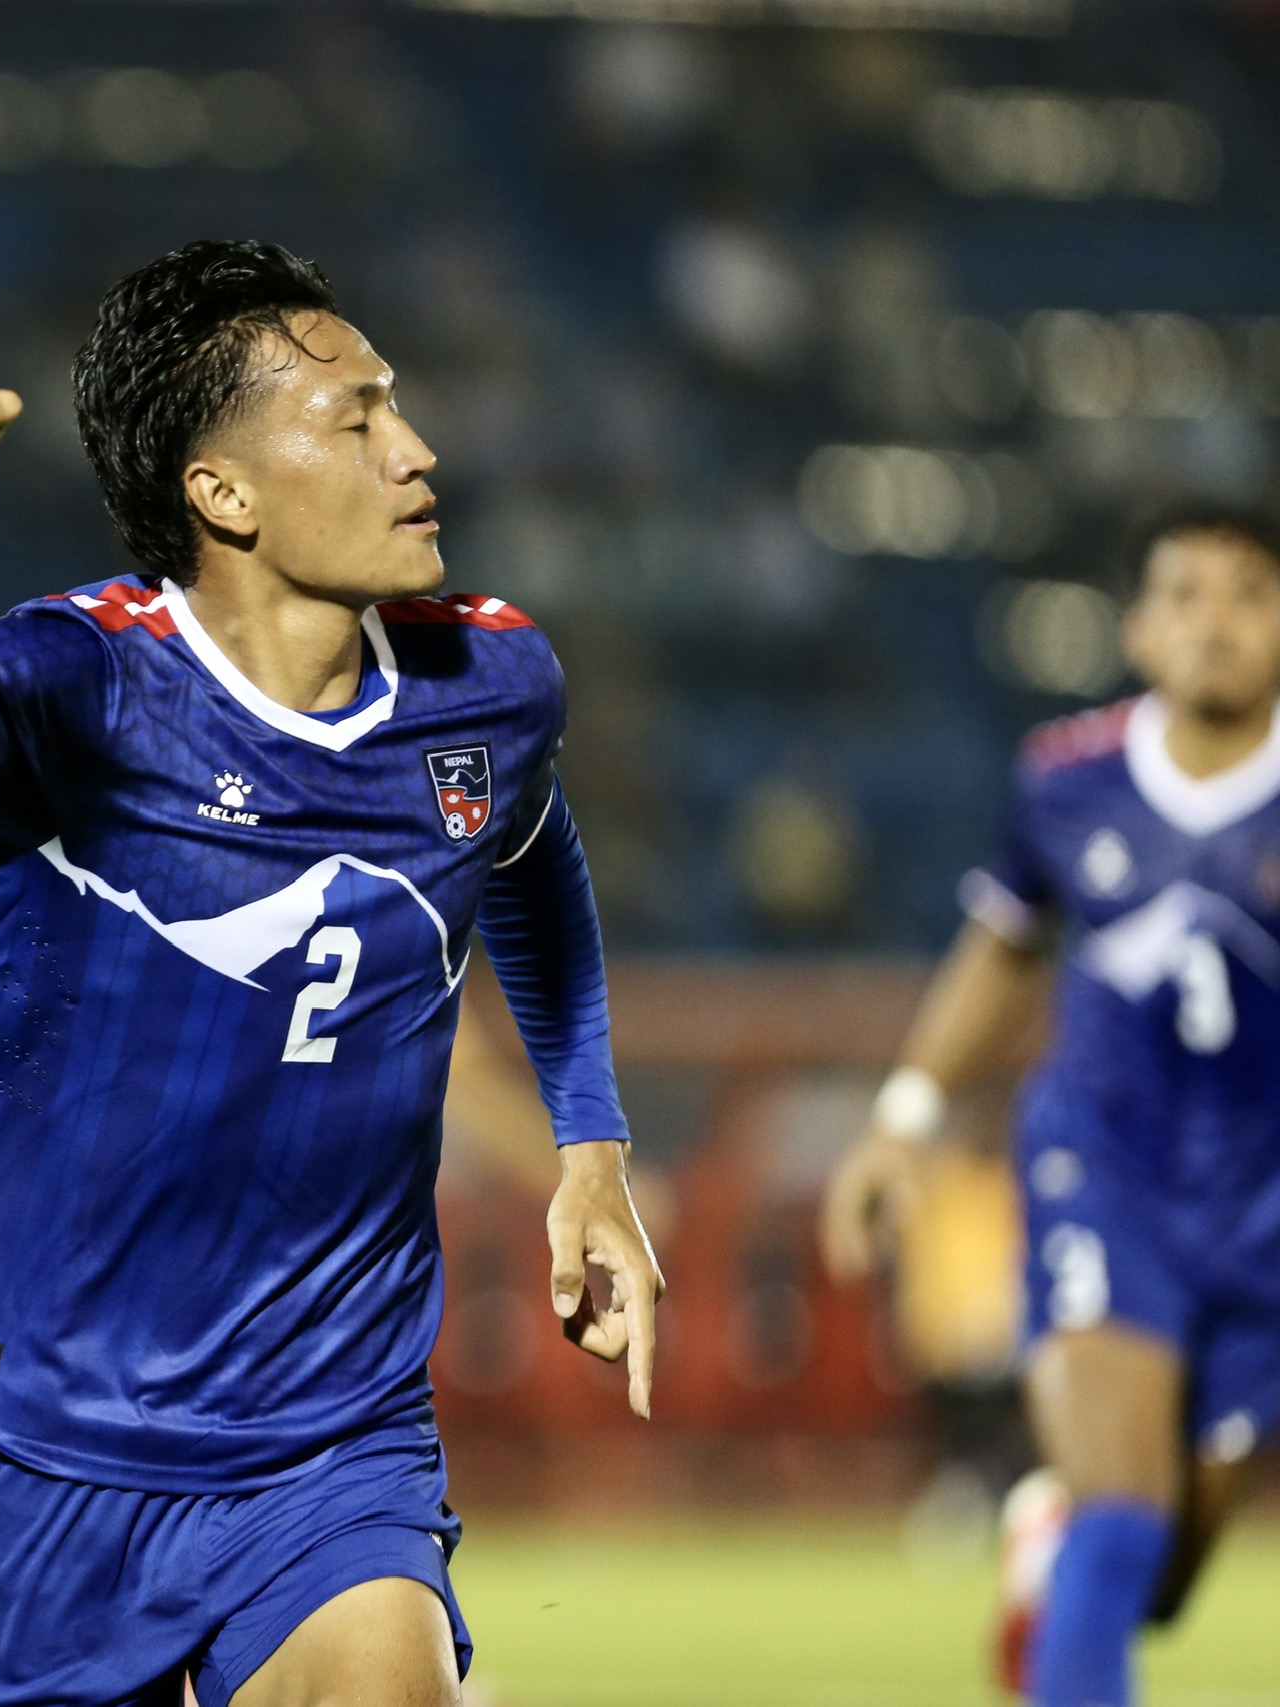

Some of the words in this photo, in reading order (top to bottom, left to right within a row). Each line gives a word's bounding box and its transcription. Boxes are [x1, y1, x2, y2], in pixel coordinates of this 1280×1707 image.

[443, 754, 474, 768] NEPAL
[197, 802, 261, 827] KELME
[281, 925, 362, 1063] 2
